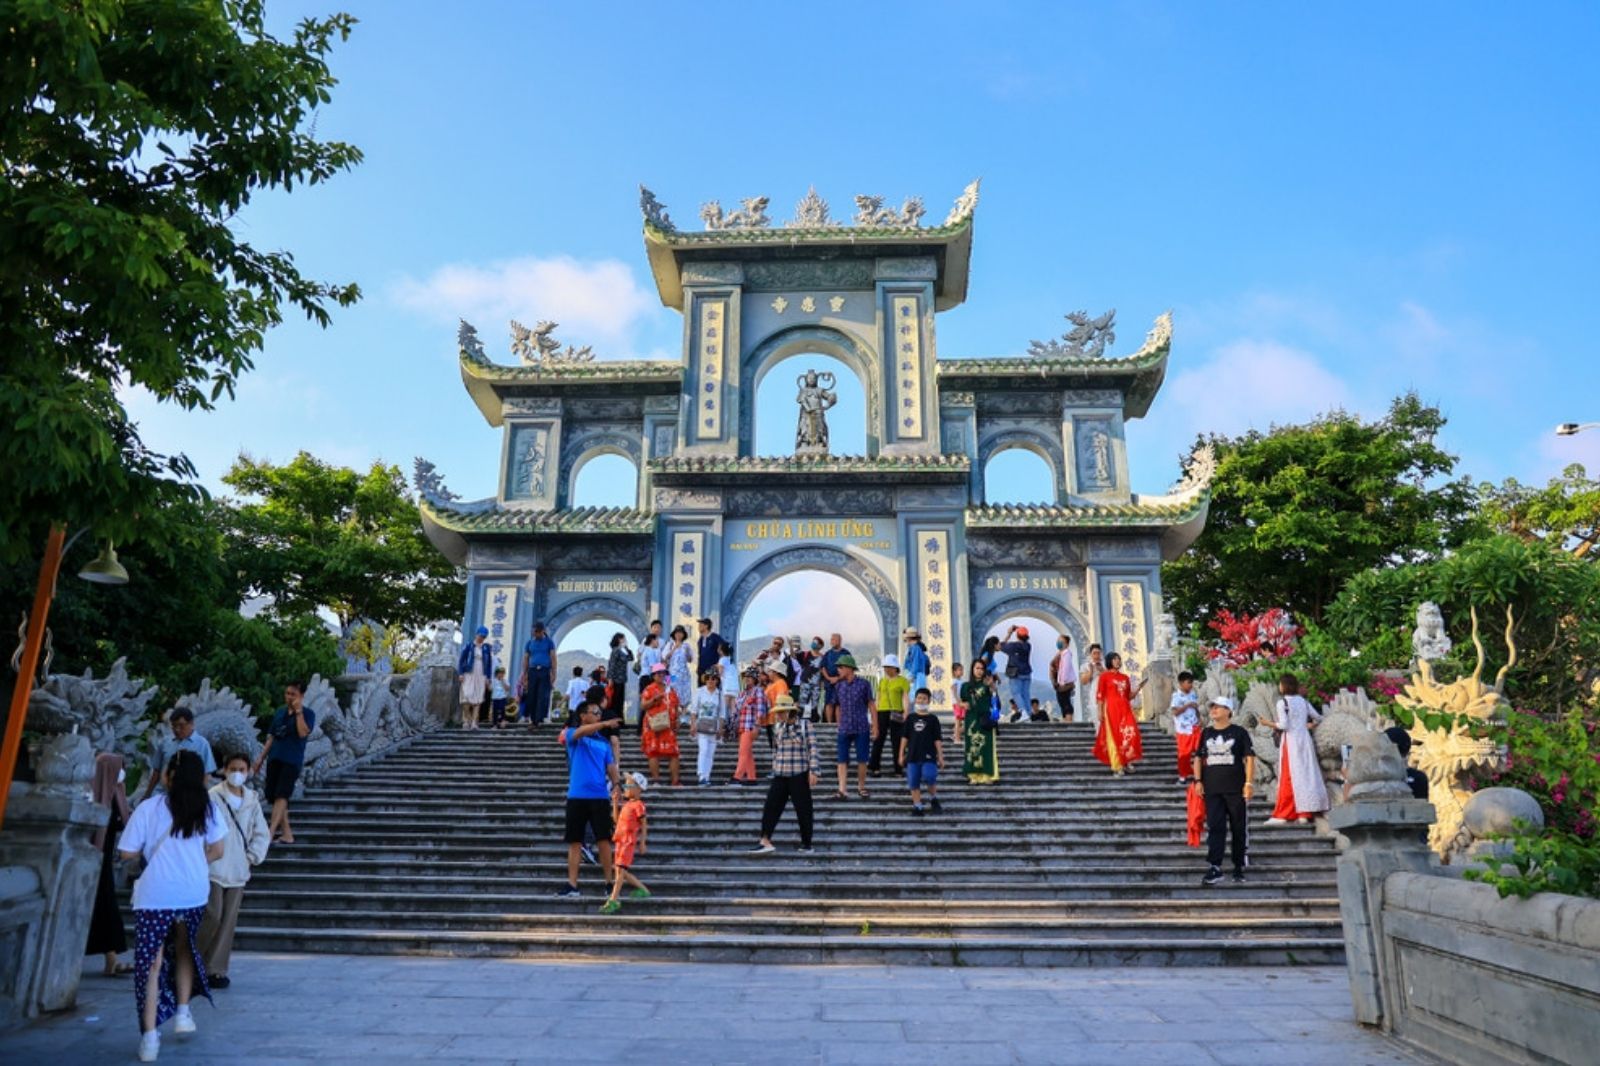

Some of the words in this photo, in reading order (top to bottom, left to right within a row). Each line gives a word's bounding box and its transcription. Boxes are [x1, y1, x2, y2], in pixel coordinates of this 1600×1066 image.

[747, 519, 792, 538] CHÙA
[798, 520, 836, 538] LINH
[841, 518, 874, 537] ỨNG
[1032, 577, 1069, 590] SANH
